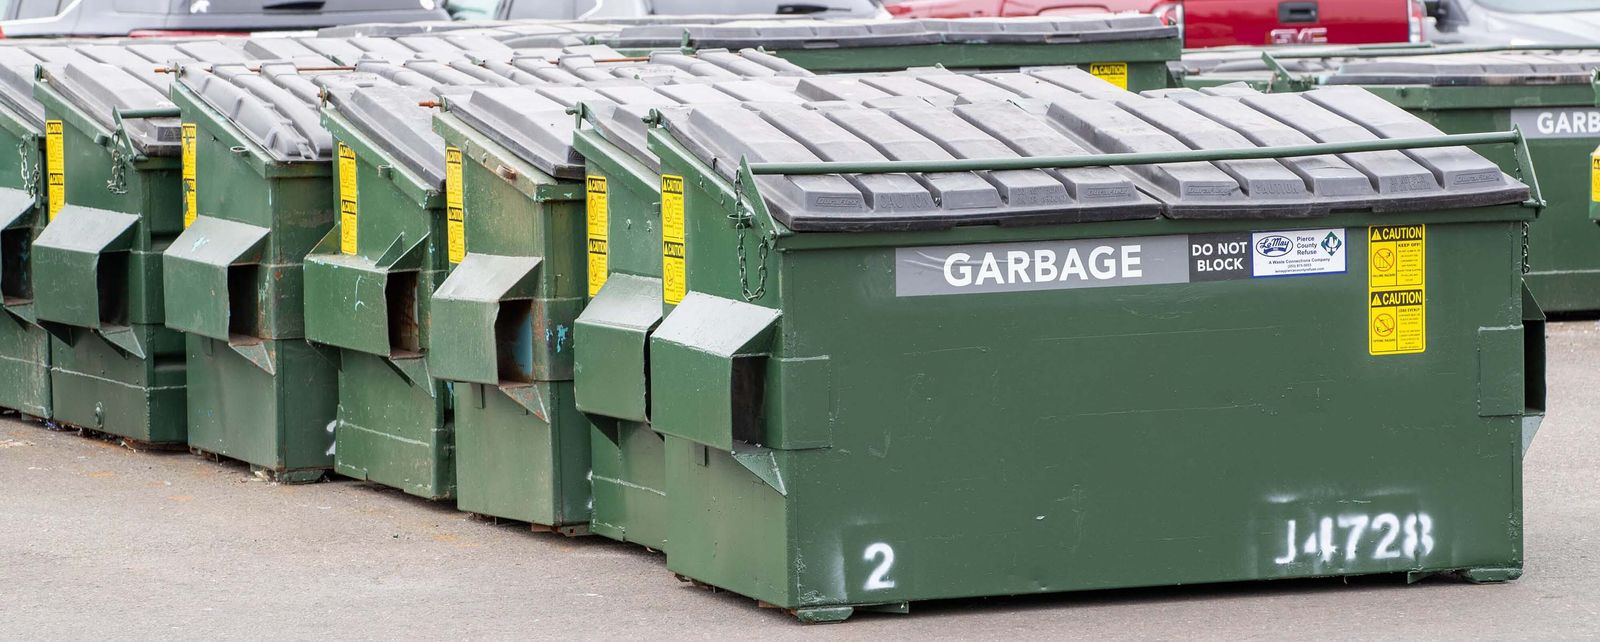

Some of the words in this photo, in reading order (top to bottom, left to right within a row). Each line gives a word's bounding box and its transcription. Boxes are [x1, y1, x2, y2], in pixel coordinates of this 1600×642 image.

[1537, 111, 1600, 134] GARB
[1382, 227, 1422, 240] CAUTION
[1192, 244, 1214, 256] DO
[1218, 242, 1248, 255] NOT
[943, 244, 1143, 287] GARBAGE
[1197, 258, 1244, 272] BLOCK
[1382, 291, 1422, 305] CAUTION
[863, 543, 895, 590] 2
